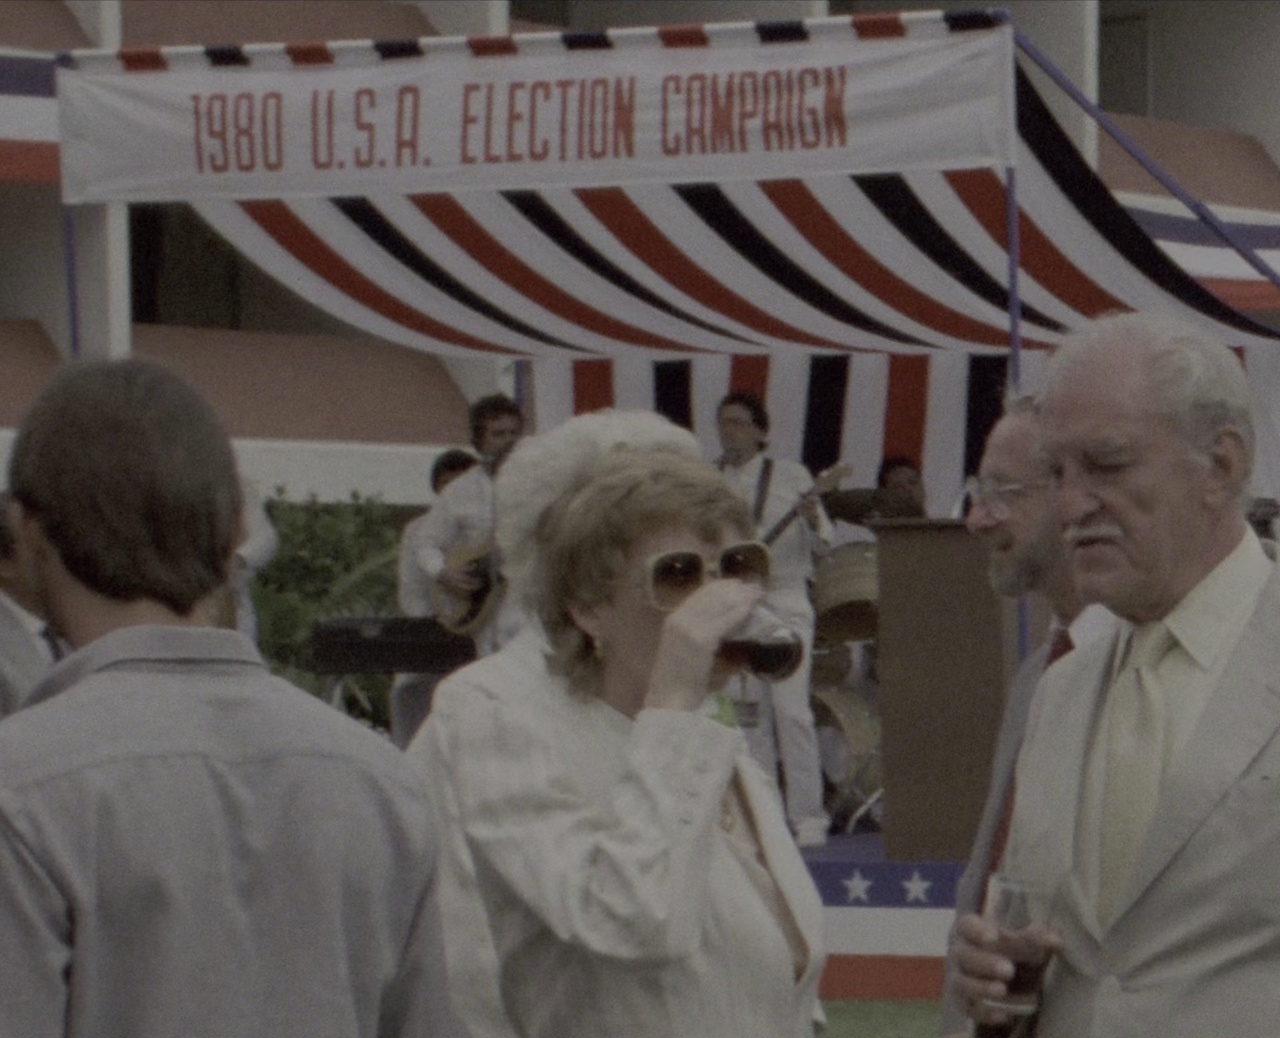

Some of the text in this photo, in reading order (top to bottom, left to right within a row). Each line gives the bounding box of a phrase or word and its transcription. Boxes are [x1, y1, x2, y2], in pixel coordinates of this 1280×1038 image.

[191, 66, 848, 174] 1980 U.S.A. ELECTION CAMPAIGN
